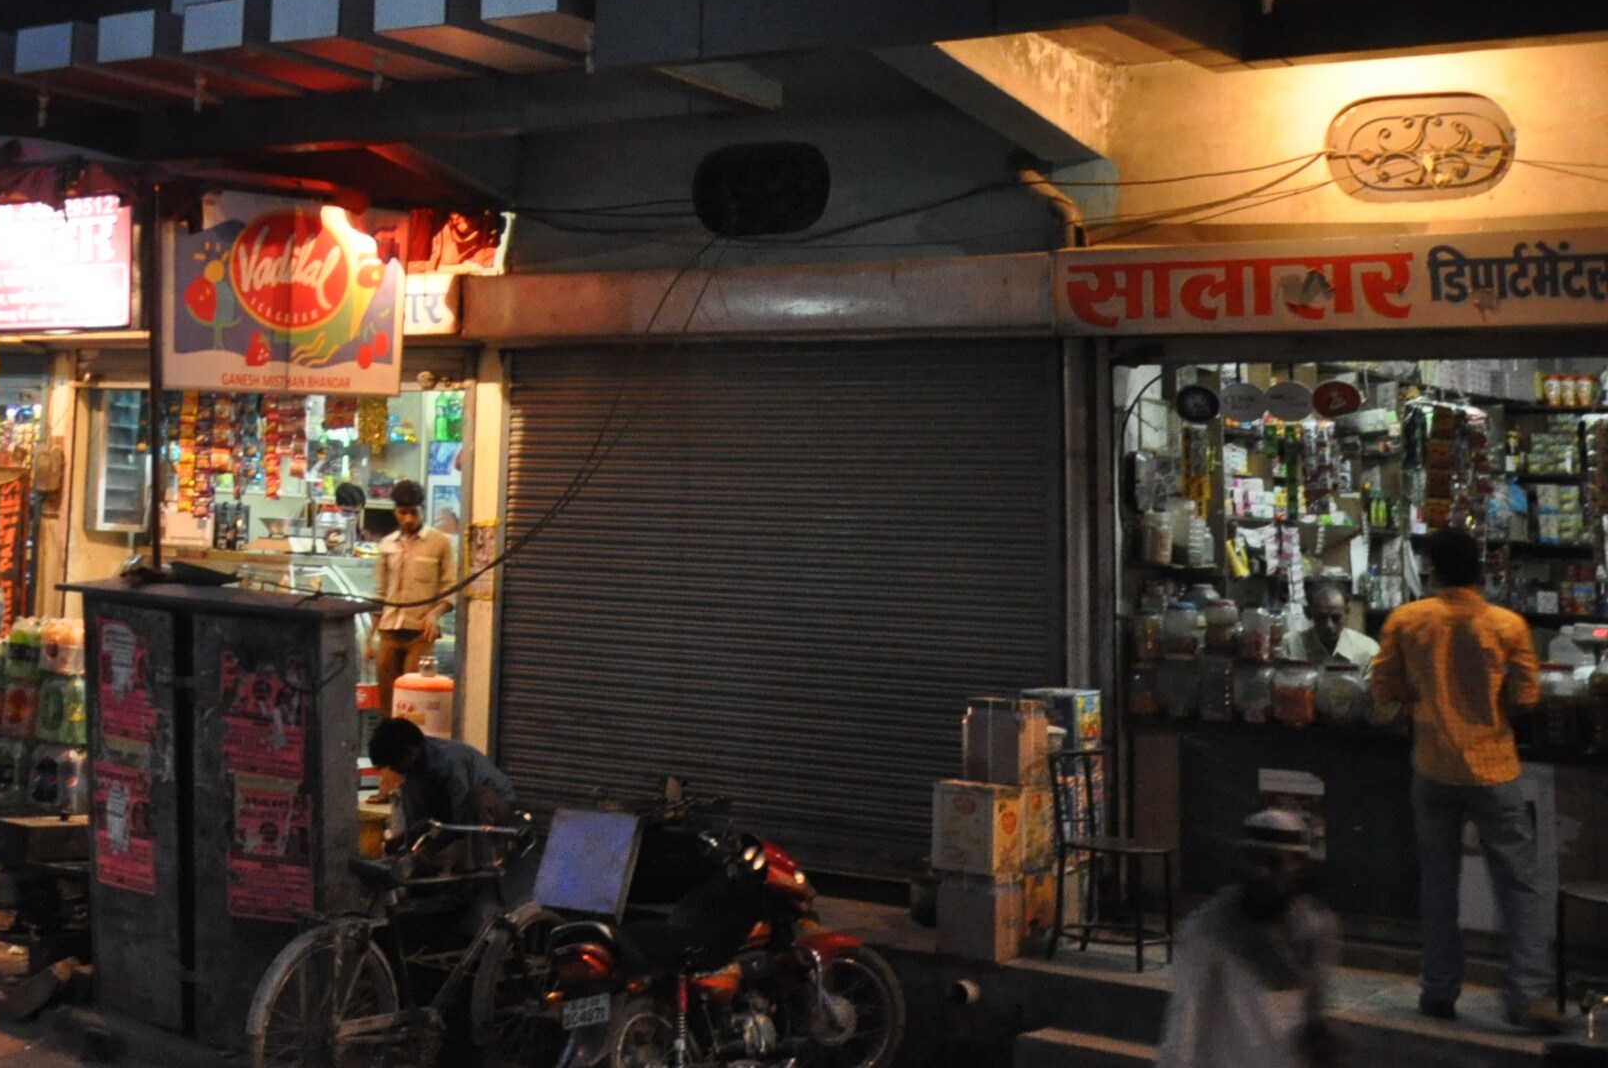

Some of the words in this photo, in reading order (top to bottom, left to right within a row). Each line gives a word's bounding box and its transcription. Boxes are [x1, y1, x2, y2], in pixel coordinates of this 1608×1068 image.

[238, 226, 342, 309] Vadilal
[221, 373, 260, 386] GANESH
[307, 377, 352, 388] BHANDAR
